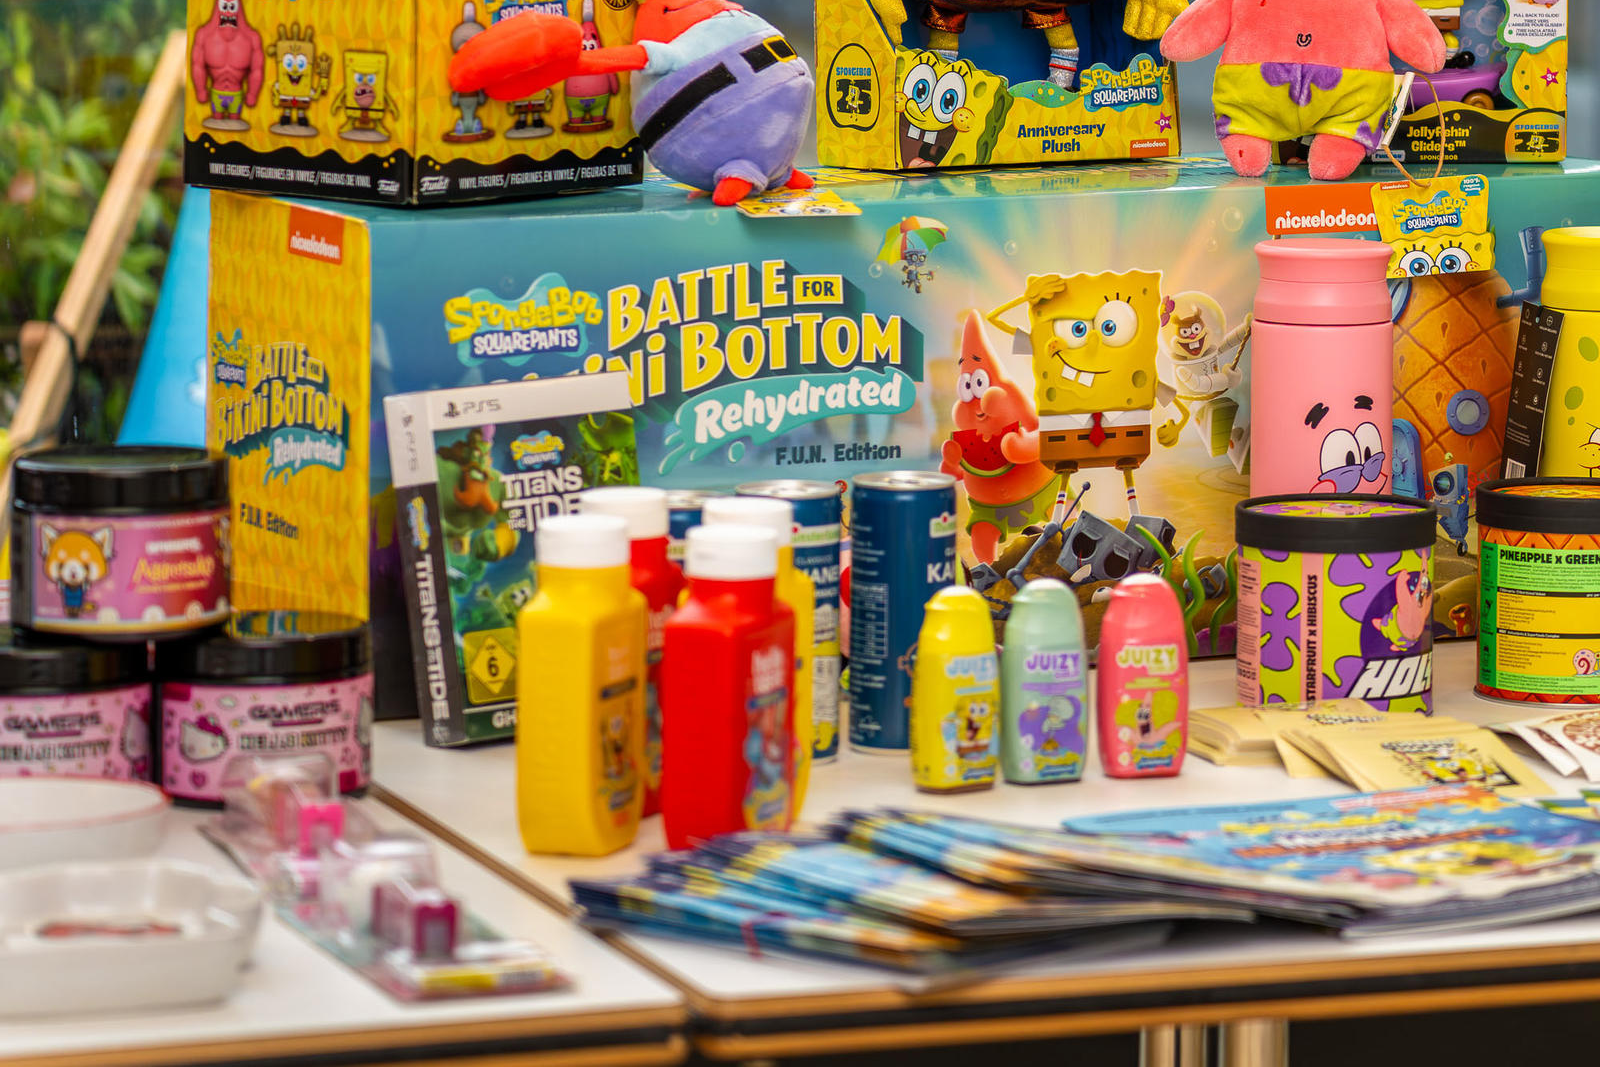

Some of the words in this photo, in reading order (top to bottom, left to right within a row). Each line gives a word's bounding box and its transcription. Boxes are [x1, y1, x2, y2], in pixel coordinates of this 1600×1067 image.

[1079, 58, 1171, 98] SpongeBob
[1093, 87, 1158, 105] SQUAREPANTS
[1017, 122, 1105, 139] Anniversary
[1042, 138, 1081, 154] Plush
[1132, 140, 1167, 149] nickelodeon
[480, 174, 504, 188] FIGURES
[510, 172, 541, 186] FIGURINES
[543, 171, 552, 183] EN
[554, 169, 574, 182] VINYLE
[581, 166, 605, 179] FIGURAS
[607, 165, 615, 177] DE
[617, 164, 632, 176] VINIL
[1276, 210, 1378, 229] nickelodeon
[1393, 196, 1468, 224] SpongeBob
[1407, 215, 1458, 229] SQUAREPANTS
[290, 231, 340, 259] nickelodeon
[444, 285, 604, 344] SpongeBob
[608, 259, 790, 351] BATTLE
[802, 280, 835, 298] FOR
[474, 329, 579, 356] SQUAREPANTS
[680, 312, 902, 393] BOTTOM
[253, 341, 308, 386] BATTLE
[270, 380, 343, 435] BOTTOM
[463, 399, 501, 414] PS5
[693, 373, 903, 445] Rehydrated
[273, 435, 342, 469] Rehydrated
[775, 446, 827, 466] F.U.N.
[834, 442, 901, 463] Edition
[1500, 549, 1552, 564] PINEAPPLE
[1306, 574, 1317, 627] HIBISCUS
[487, 656, 499, 676] 6
[1026, 653, 1080, 671] JUIZY
[1117, 645, 1177, 666] JUIZY
[1306, 639, 1317, 702] STARFRUIT
